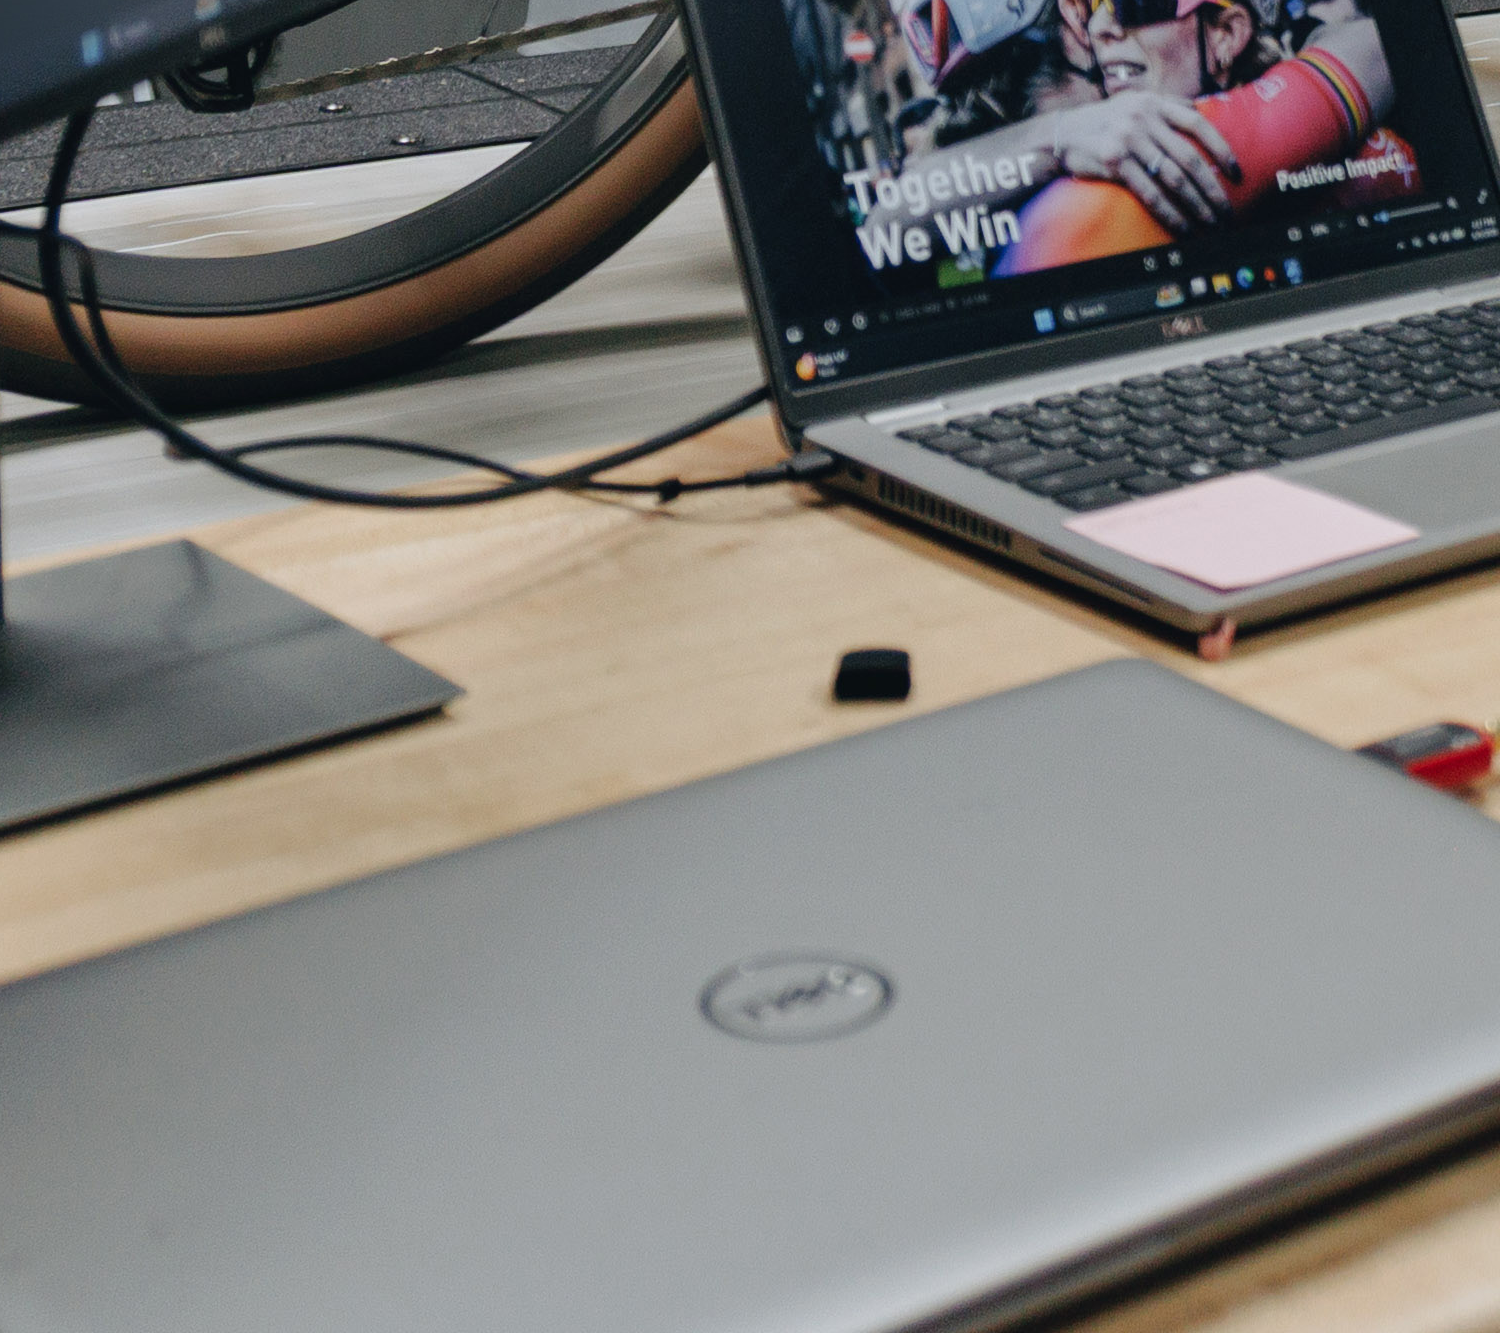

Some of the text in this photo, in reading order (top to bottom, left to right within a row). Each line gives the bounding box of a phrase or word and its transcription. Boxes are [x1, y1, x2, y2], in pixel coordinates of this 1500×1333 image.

[843, 153, 1037, 217] Together
[1276, 151, 1407, 193] Positive Impact
[856, 204, 1022, 270] We Win
